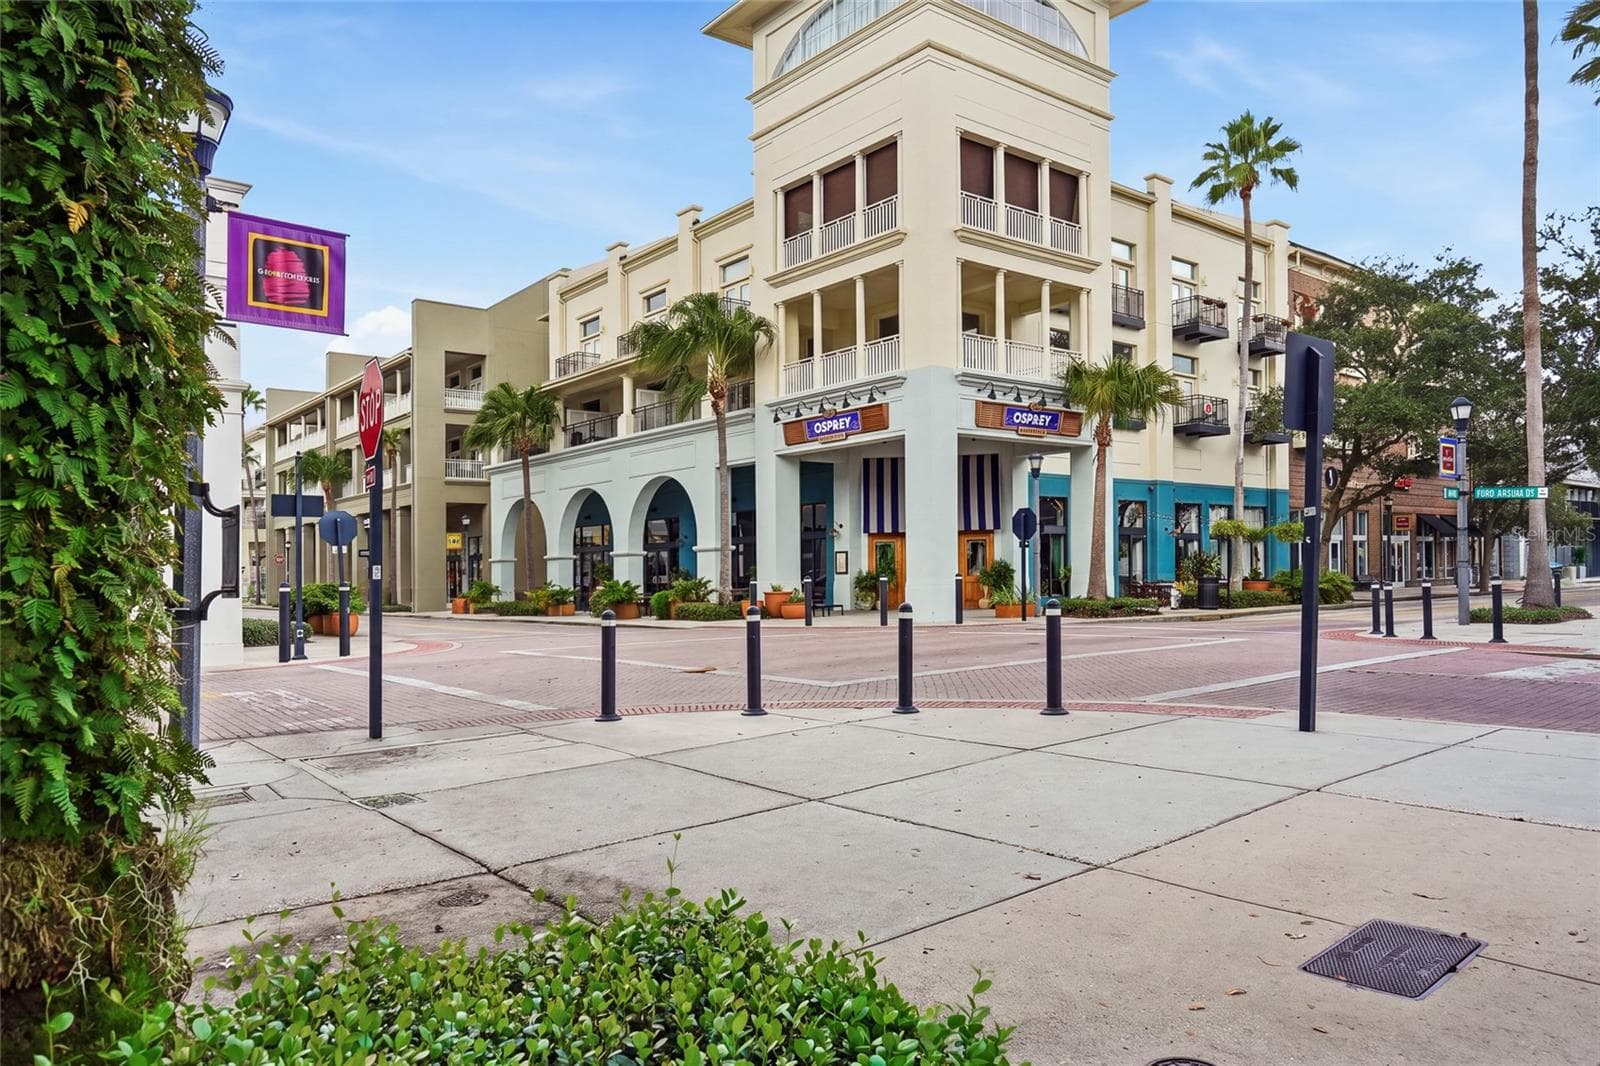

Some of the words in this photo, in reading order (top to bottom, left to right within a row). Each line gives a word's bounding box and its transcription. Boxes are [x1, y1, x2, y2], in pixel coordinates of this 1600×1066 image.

[360, 388, 381, 432] STOP
[814, 416, 852, 434] OSPREY
[1013, 412, 1052, 427] OSPREY
